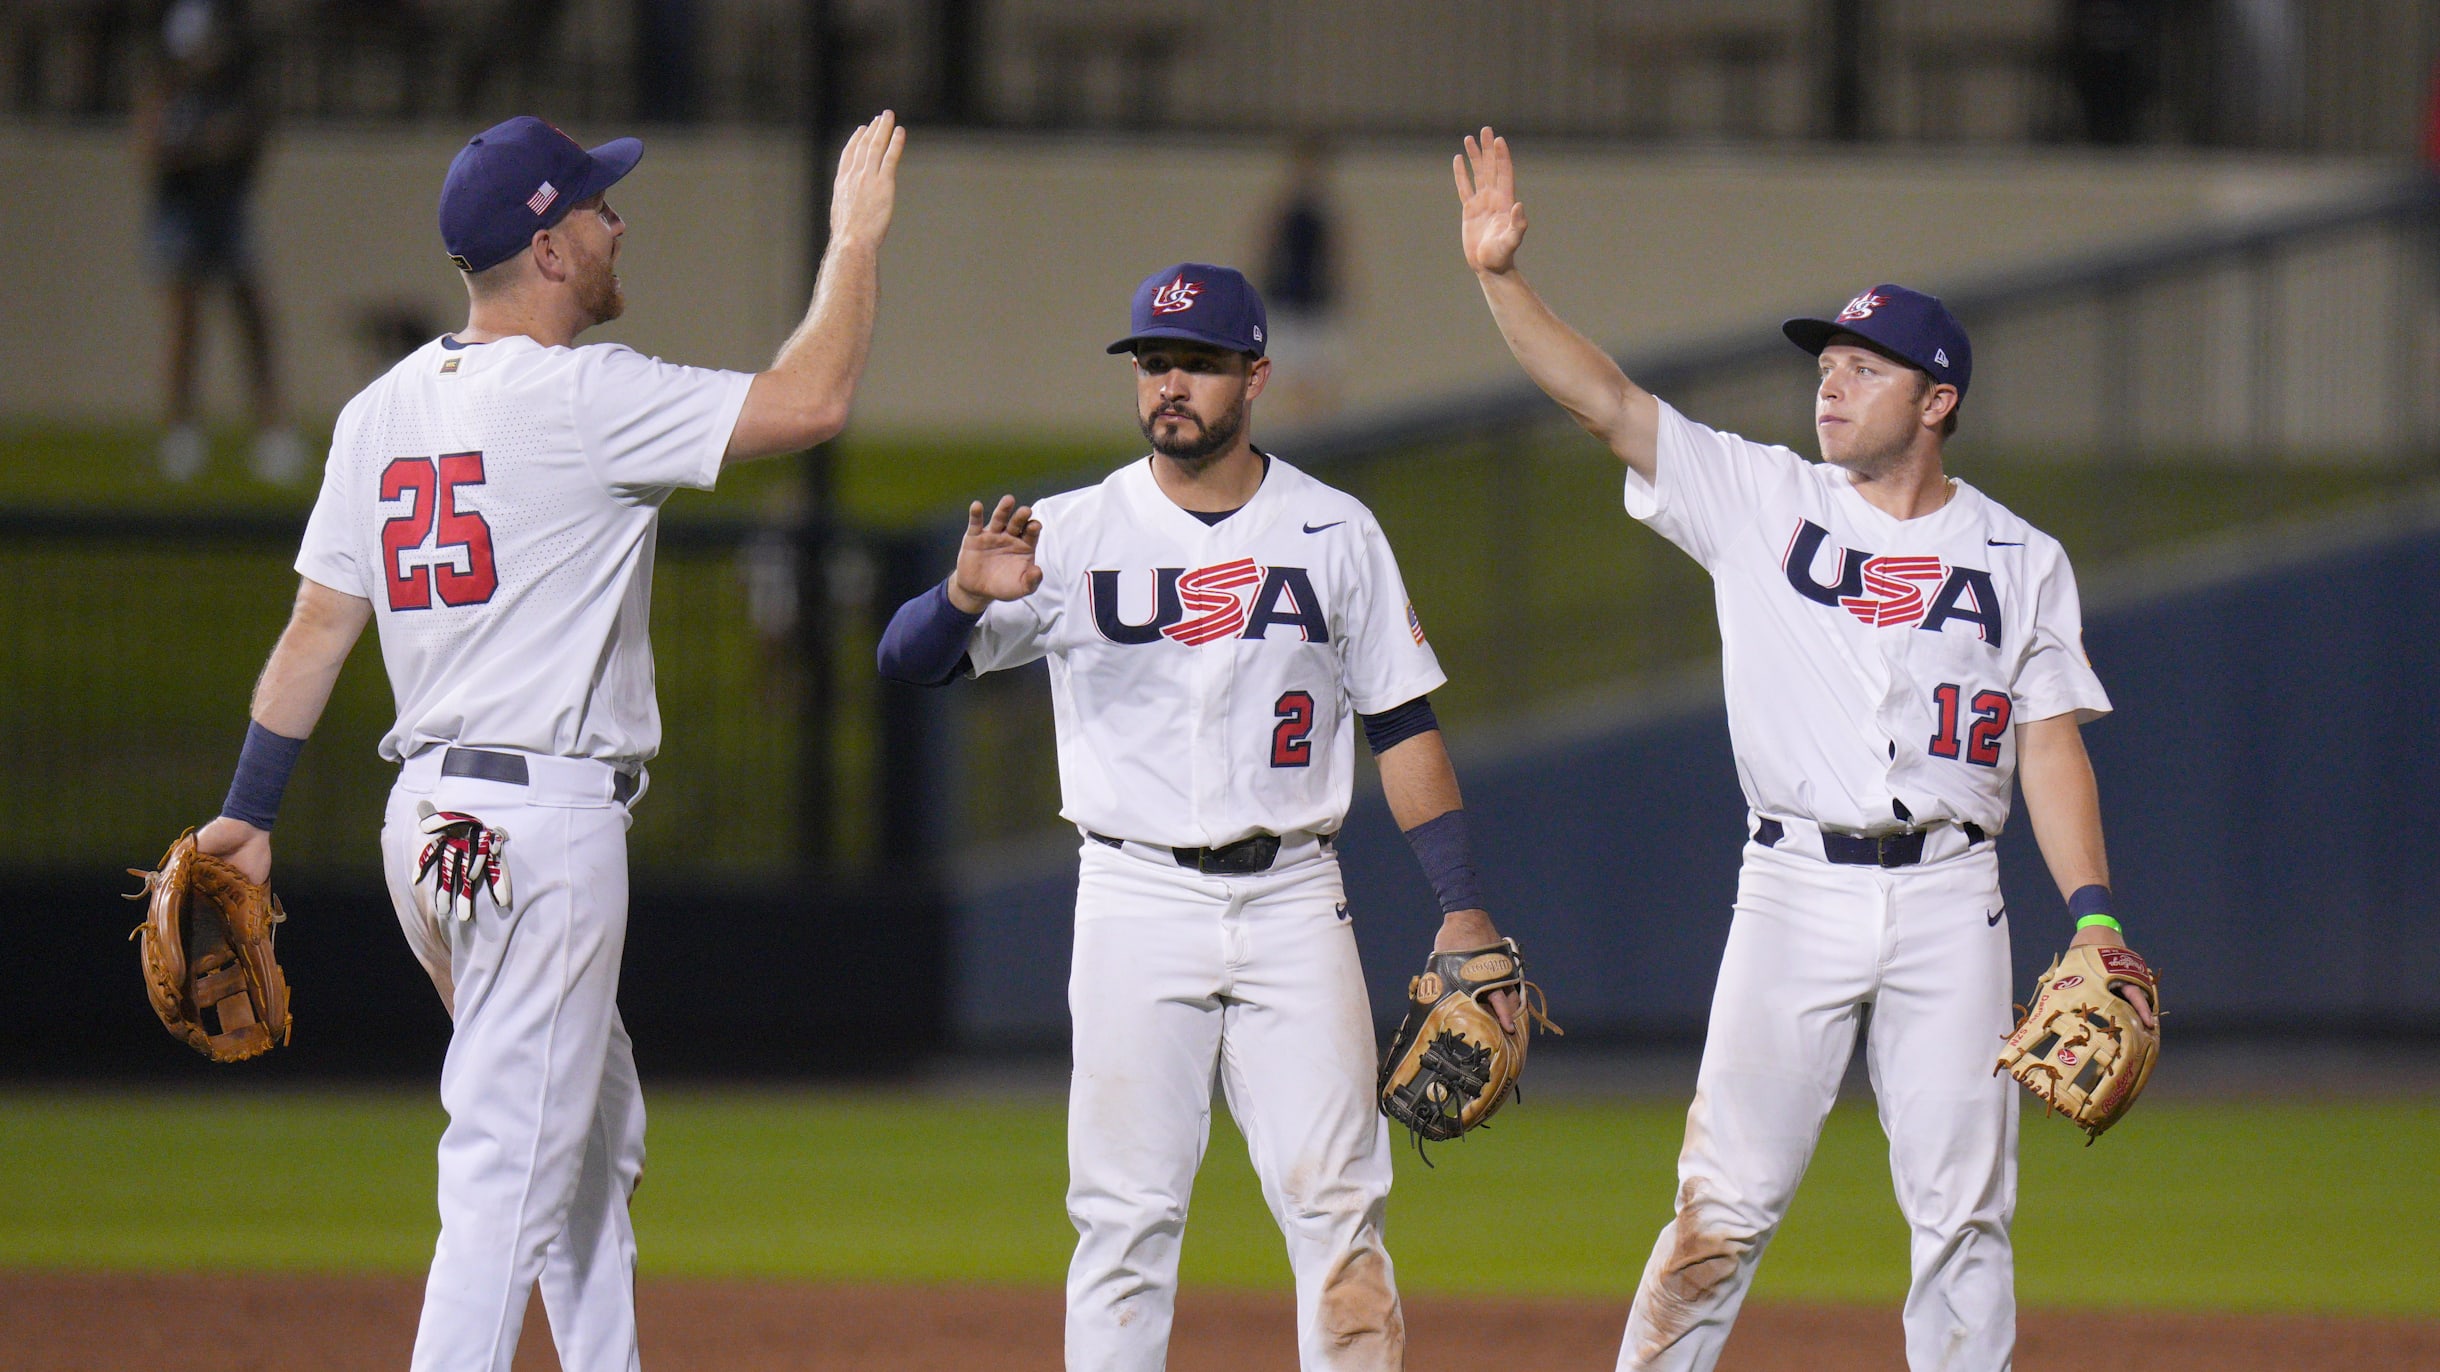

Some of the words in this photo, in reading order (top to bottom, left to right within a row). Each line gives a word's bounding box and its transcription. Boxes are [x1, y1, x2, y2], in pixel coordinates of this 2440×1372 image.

[379, 451, 499, 611] 25
[1085, 556, 1329, 647] USA
[1780, 516, 2003, 648] USA
[1270, 690, 1315, 768] 2
[1928, 683, 2012, 768] 12
